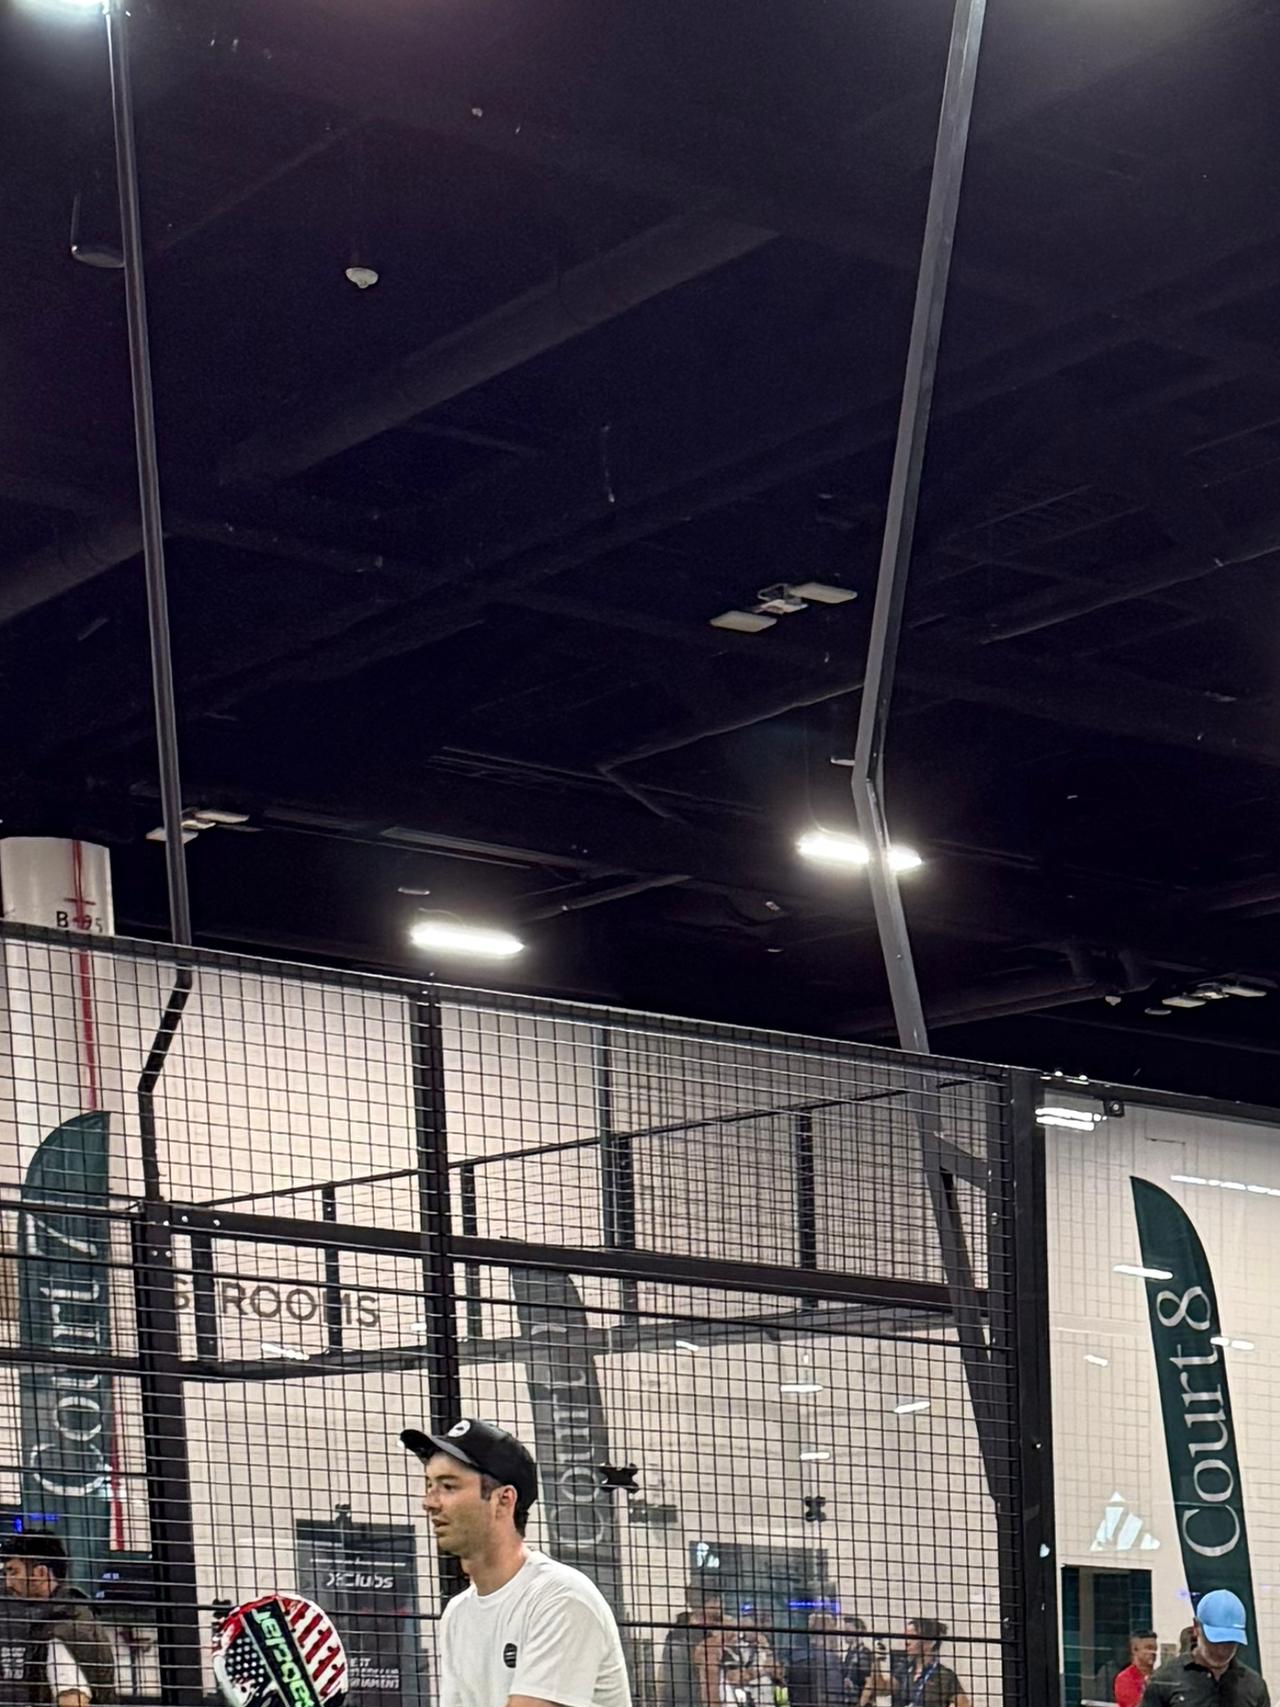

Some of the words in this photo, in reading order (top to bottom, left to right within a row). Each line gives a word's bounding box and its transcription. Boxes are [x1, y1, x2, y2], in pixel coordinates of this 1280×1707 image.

[25, 1213, 98, 1257] 7
[1155, 1285, 1212, 1331] 8
[27, 1277, 106, 1497] Court
[1168, 1343, 1241, 1557] Court
